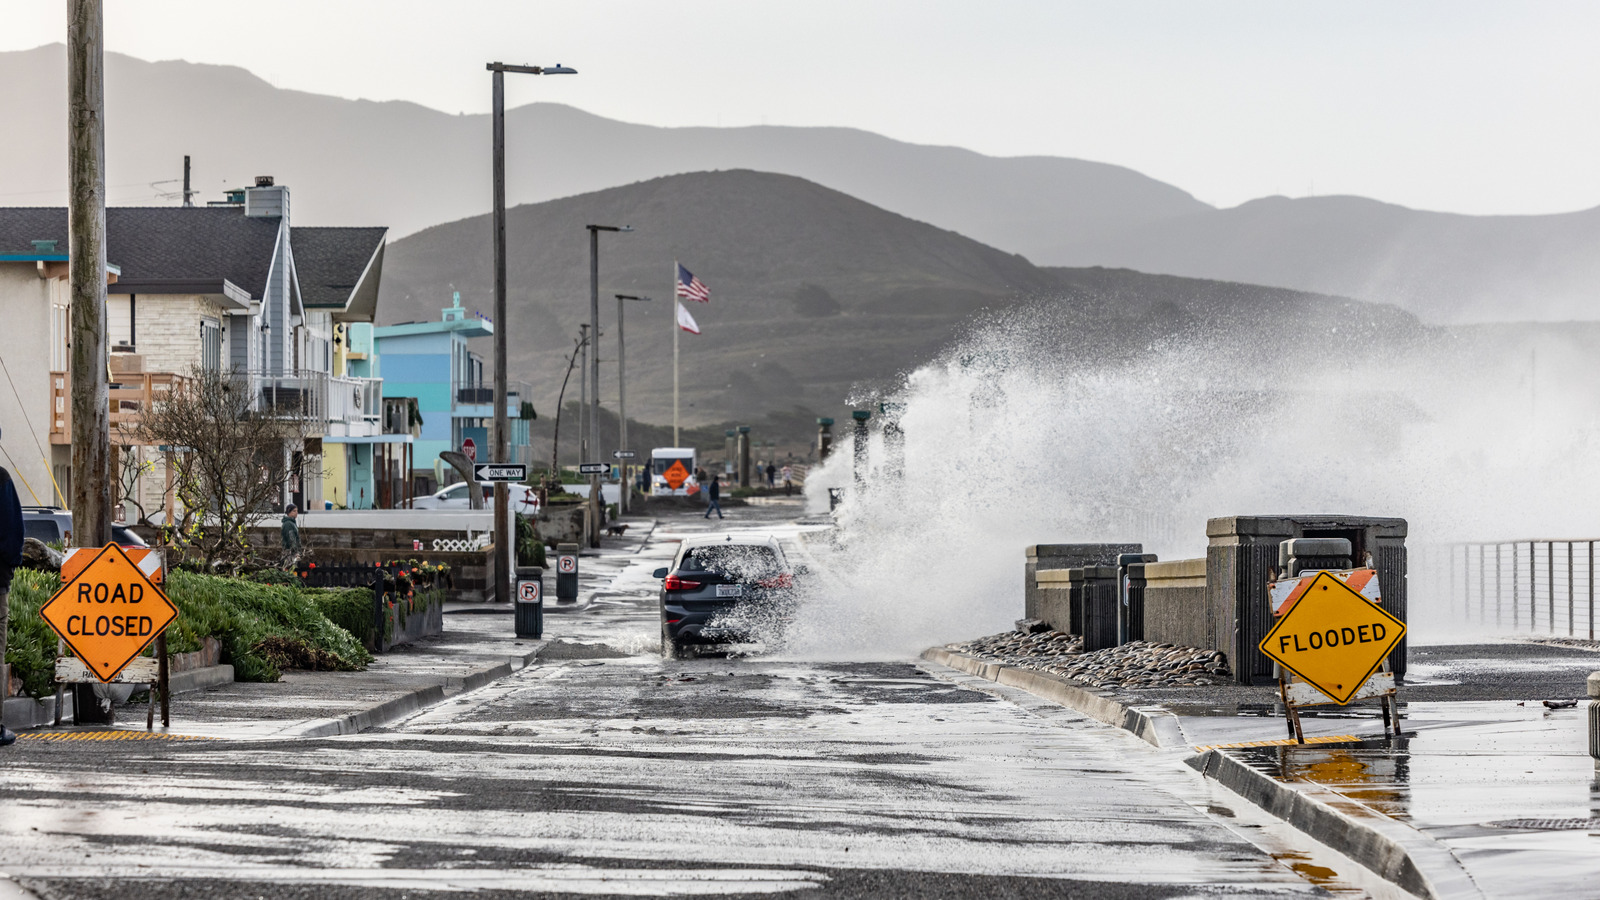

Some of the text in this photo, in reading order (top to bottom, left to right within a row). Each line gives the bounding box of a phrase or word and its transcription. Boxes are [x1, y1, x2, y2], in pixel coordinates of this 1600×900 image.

[463, 446, 475, 456] STOP
[489, 469, 504, 477] ONE
[564, 560, 572, 568] P
[77, 582, 144, 604] ROAD
[525, 586, 534, 597] P
[66, 615, 153, 637] CLOSED
[1279, 623, 1386, 654] FLOODED
